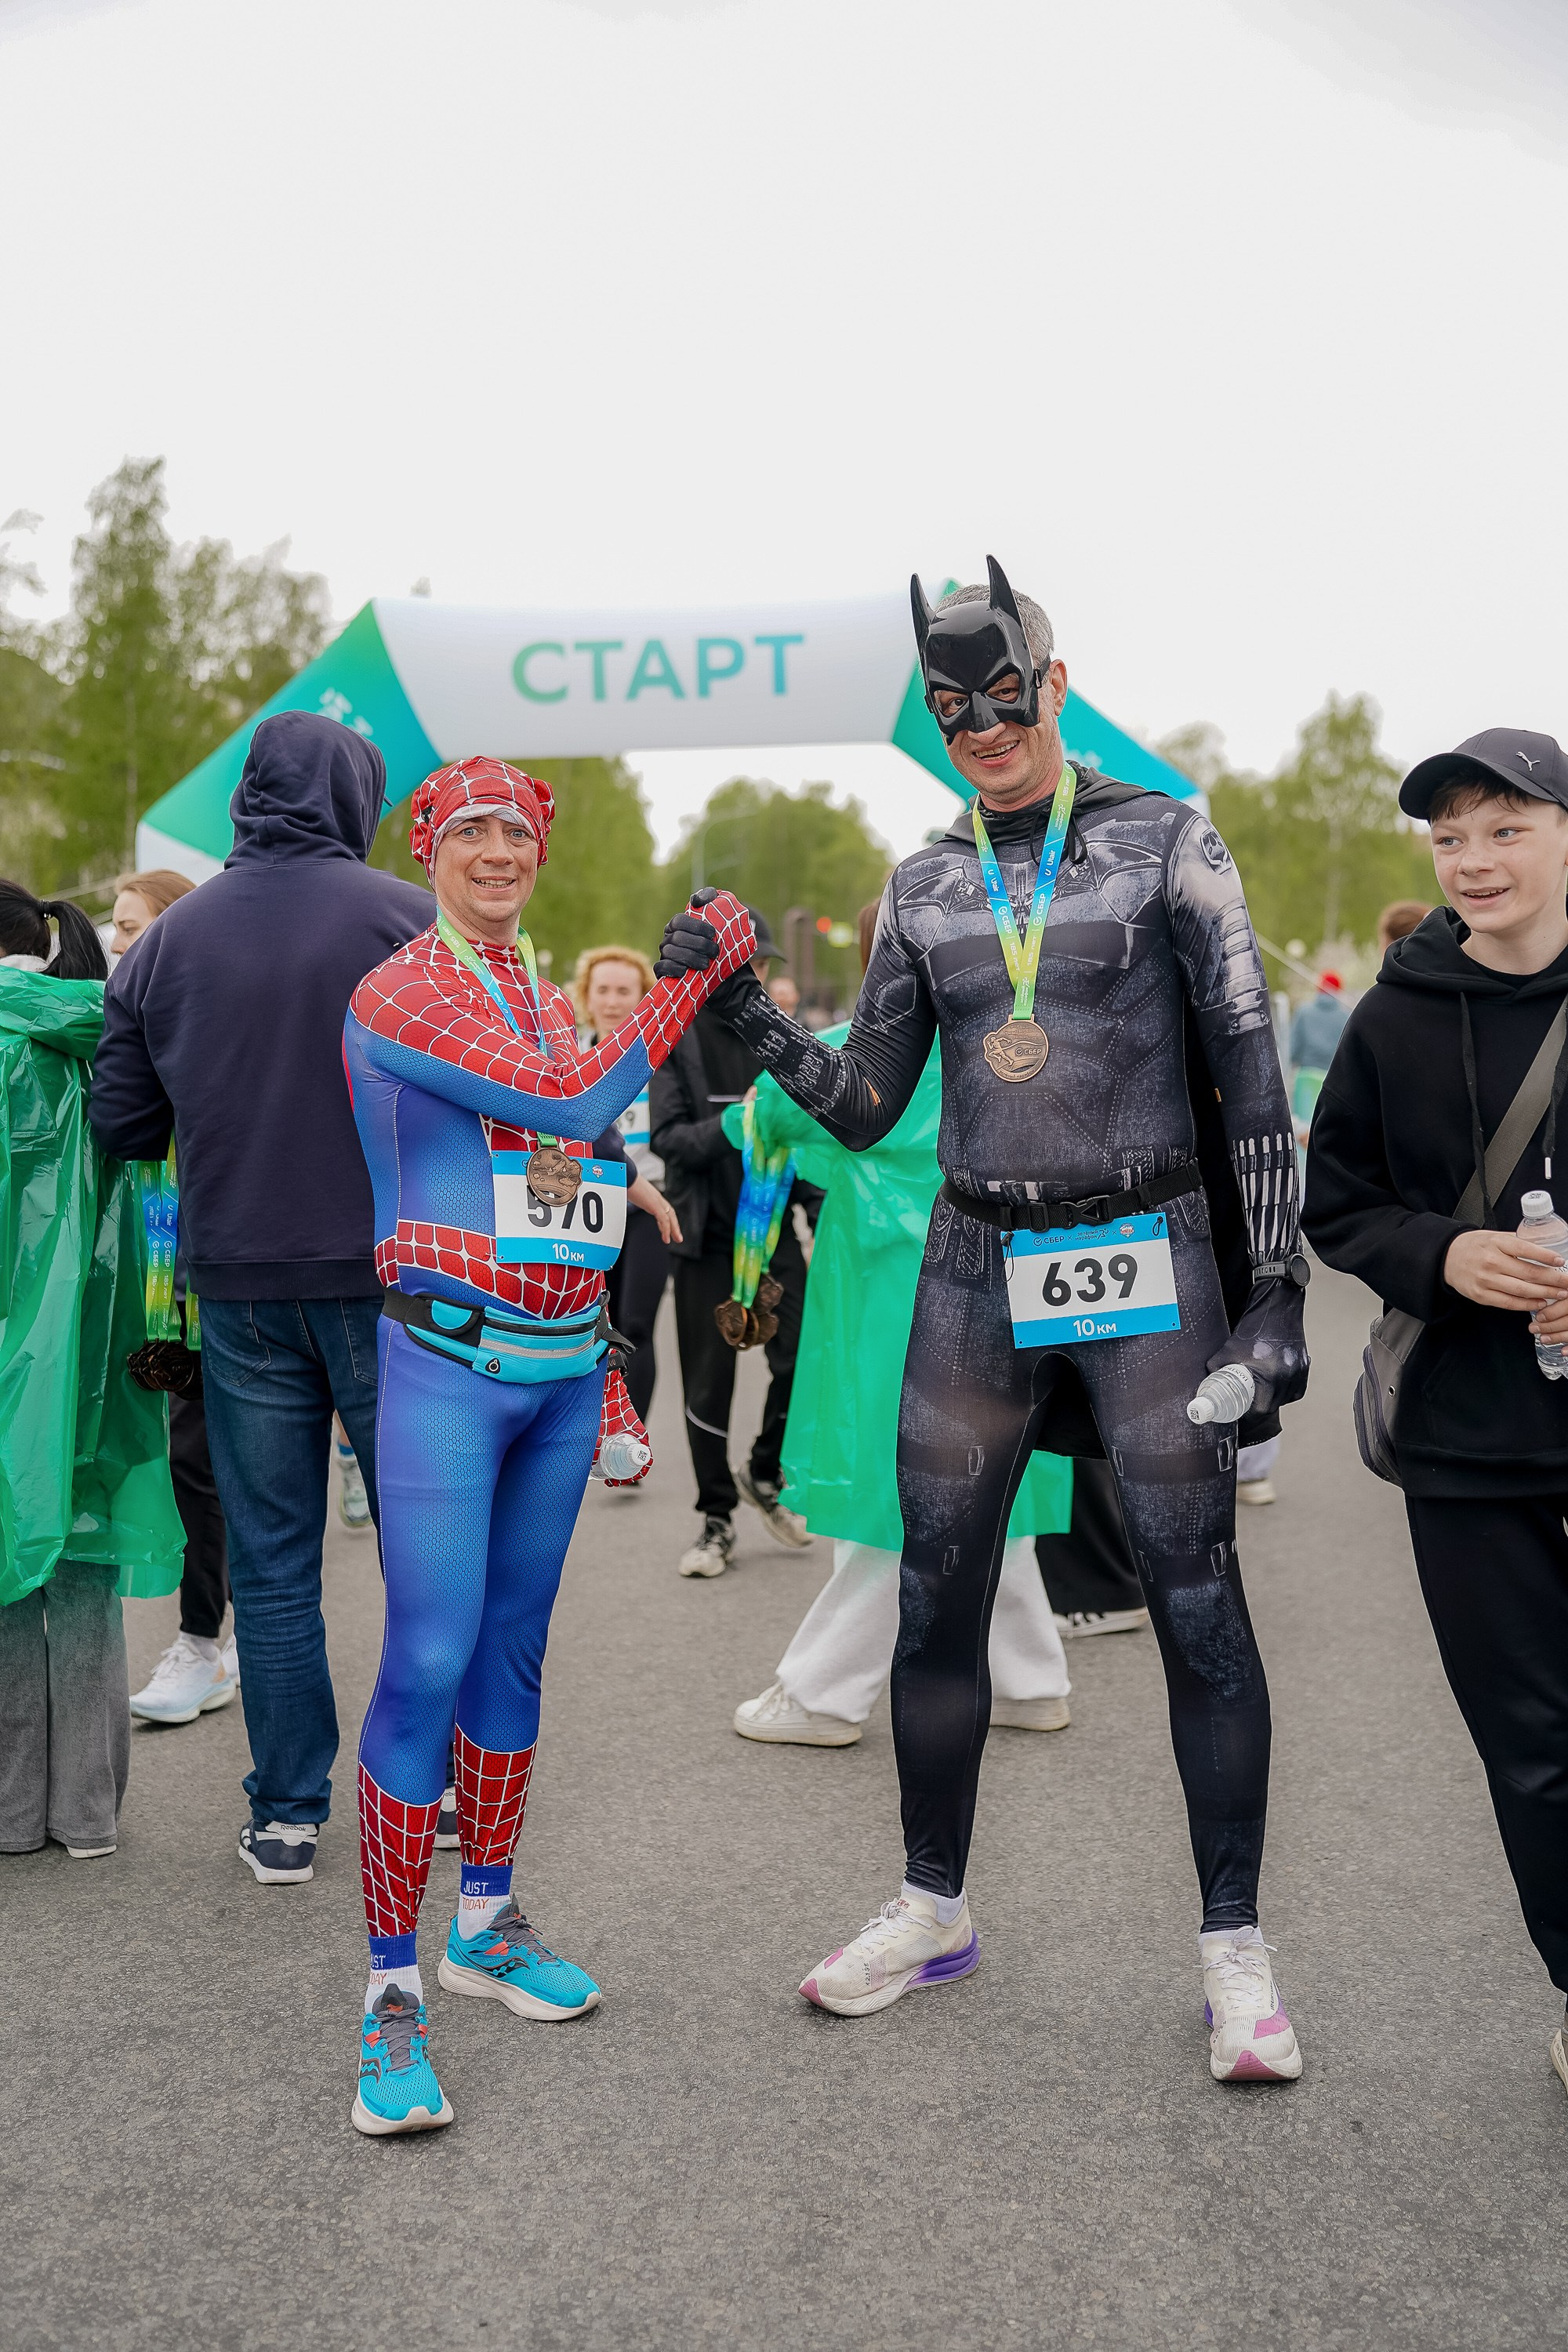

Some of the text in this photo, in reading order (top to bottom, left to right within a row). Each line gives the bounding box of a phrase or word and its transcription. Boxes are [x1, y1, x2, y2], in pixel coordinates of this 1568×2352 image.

[511, 633, 805, 704] СТАРТ
[1047, 849, 1056, 866] Utair
[990, 877, 1000, 892] Utair
[1036, 893, 1047, 915] СБЕР
[1001, 915, 1013, 935] СБЕР
[450, 935, 461, 949] 185
[1044, 1236, 1065, 1244] СБЕР
[1042, 1253, 1138, 1307] 639
[463, 1880, 489, 1895] JUST
[463, 1896, 490, 1911] TODAY
